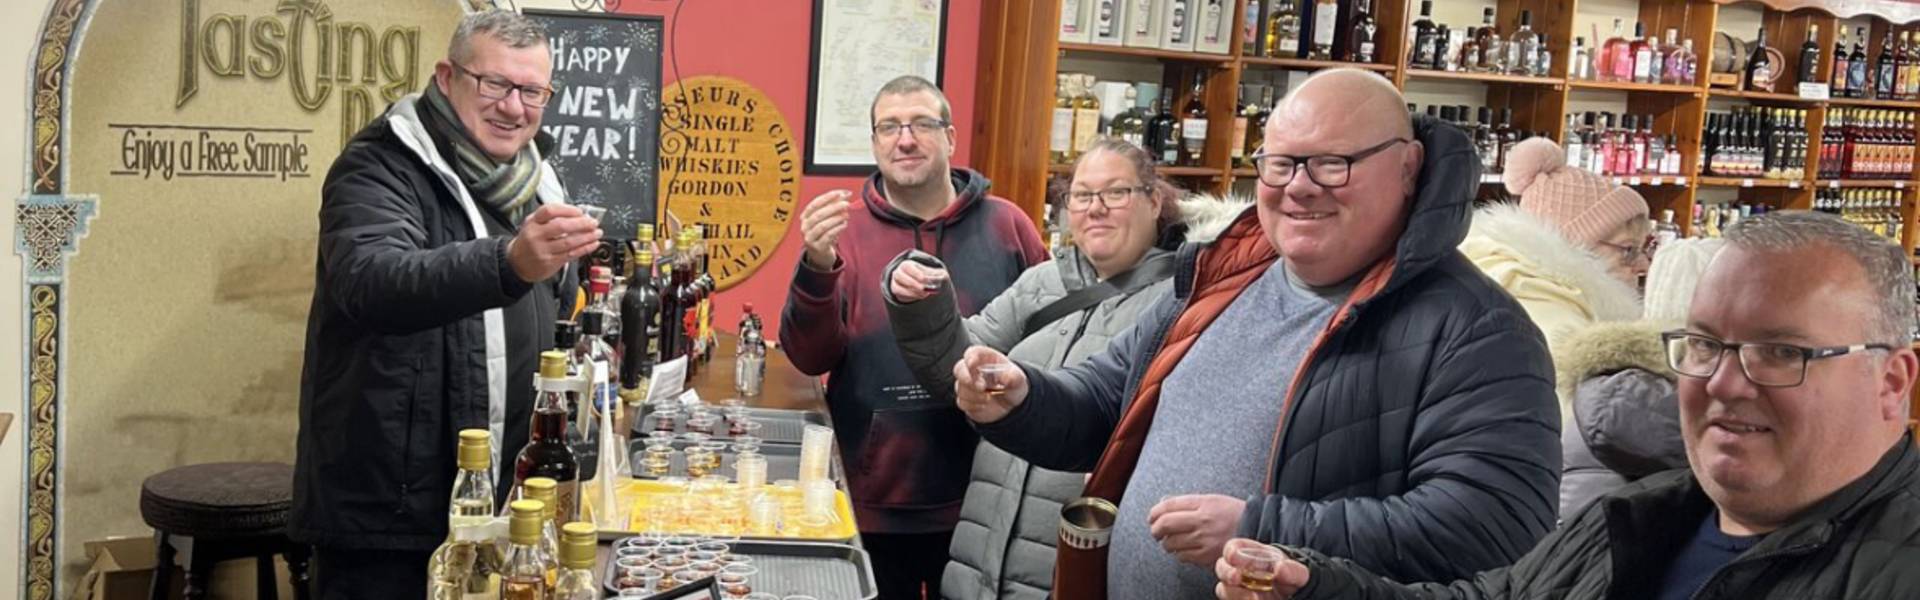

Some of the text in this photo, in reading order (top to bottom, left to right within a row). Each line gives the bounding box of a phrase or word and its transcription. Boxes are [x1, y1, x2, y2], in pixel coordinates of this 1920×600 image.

[550, 36, 631, 75] HAPPY
[558, 85, 637, 120] NEW
[662, 86, 758, 114] SEURS
[680, 114, 755, 133] SINGLE
[122, 129, 175, 181] Enjoy
[180, 140, 193, 171] a
[243, 132, 308, 181] Sample
[541, 124, 636, 160] YEAR!
[687, 136, 740, 153] MALT
[659, 156, 759, 174] WHISKIES
[768, 122, 794, 222] CHOICE
[669, 180, 748, 196] GORDON
